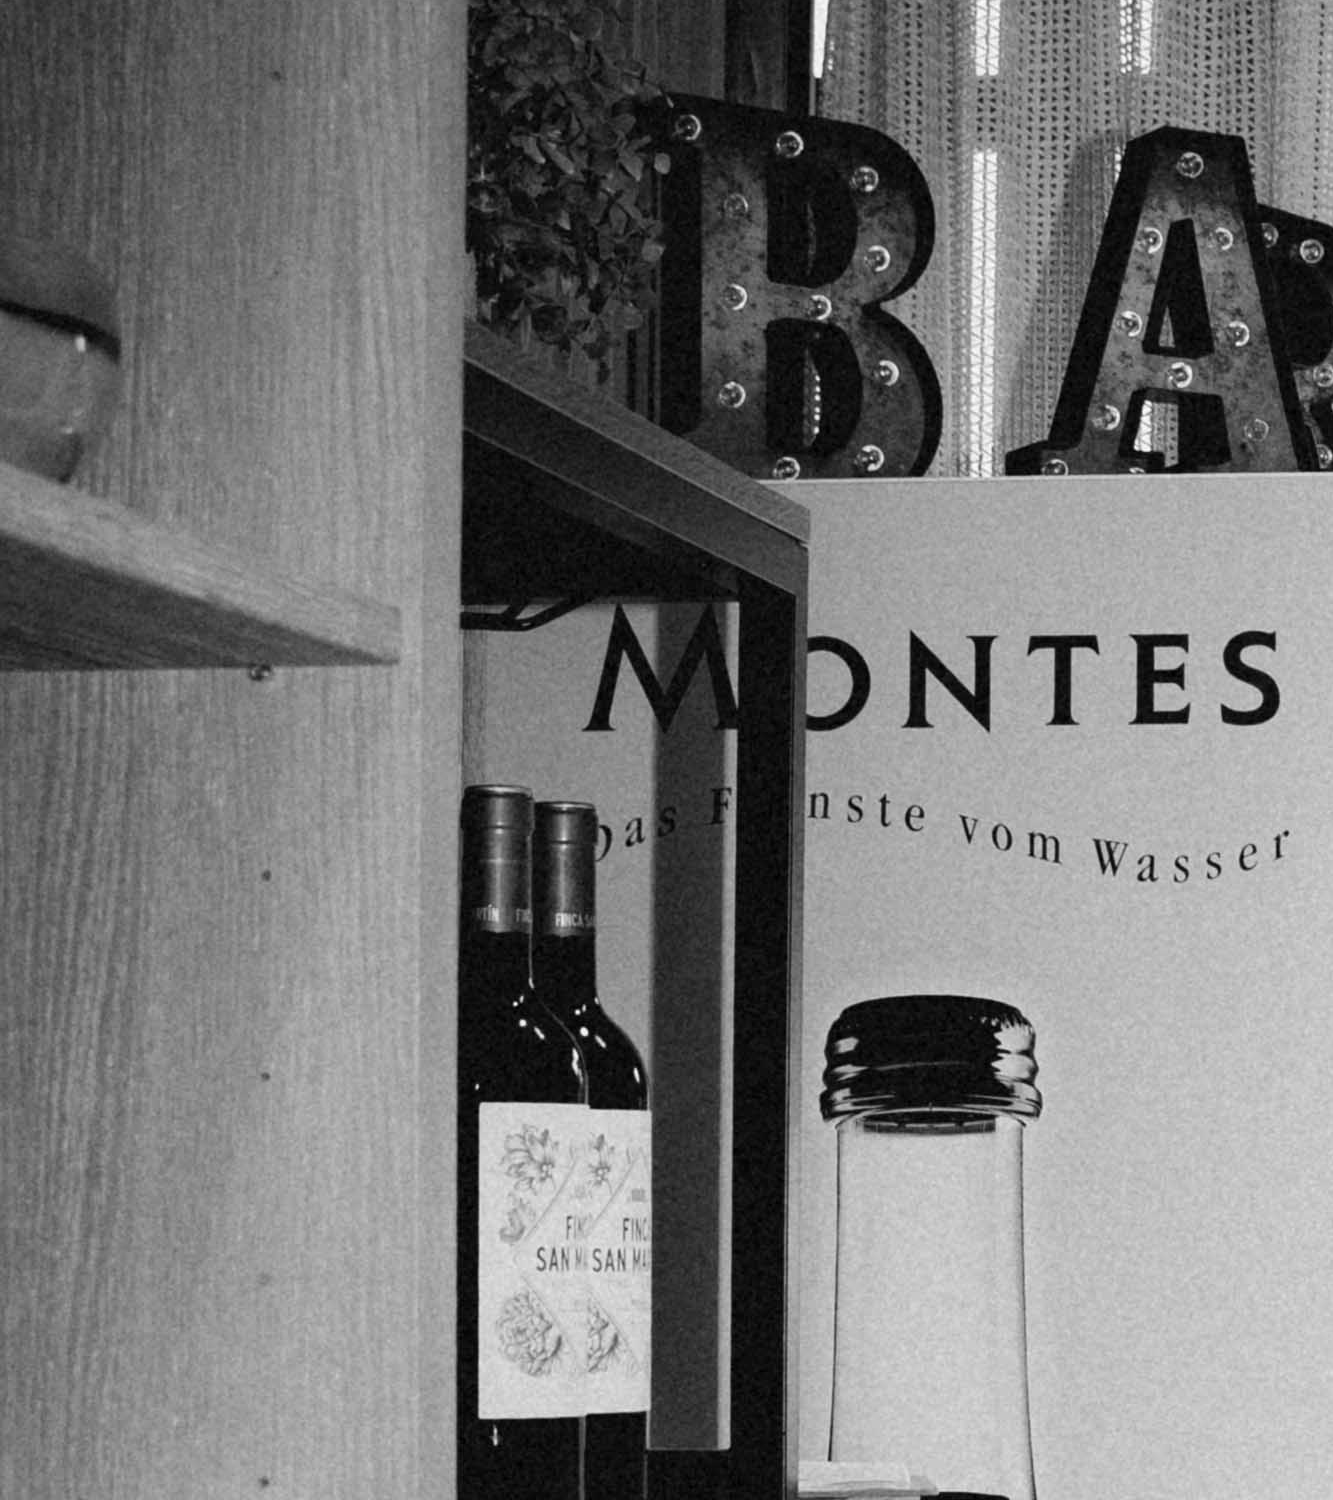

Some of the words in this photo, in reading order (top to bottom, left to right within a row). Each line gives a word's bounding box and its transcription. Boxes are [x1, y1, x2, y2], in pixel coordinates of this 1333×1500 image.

[583, 603, 1281, 733] MONTES
[708, 787, 925, 833] Fnste
[959, 816, 1062, 864] vom
[1093, 827, 1289, 885] Wasser
[536, 1246, 569, 1272] SAN
[592, 1247, 626, 1273] SAN
